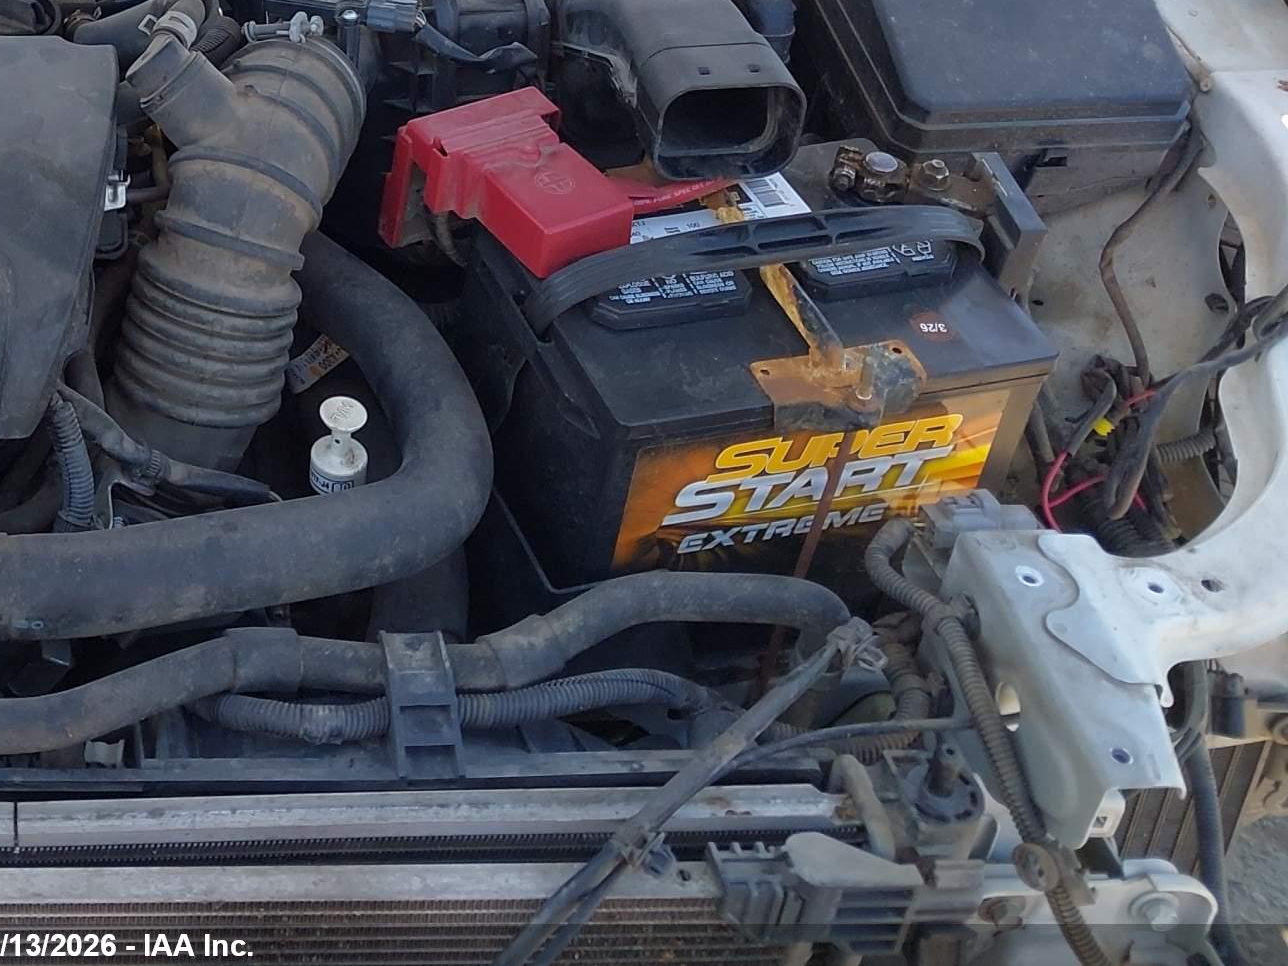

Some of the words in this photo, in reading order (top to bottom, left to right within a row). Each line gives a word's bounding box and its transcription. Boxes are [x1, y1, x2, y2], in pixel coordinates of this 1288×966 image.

[919, 322, 948, 333] 3/26
[705, 414, 964, 484] SUPER
[662, 444, 955, 527] START
[676, 502, 890, 556] EXTREME
